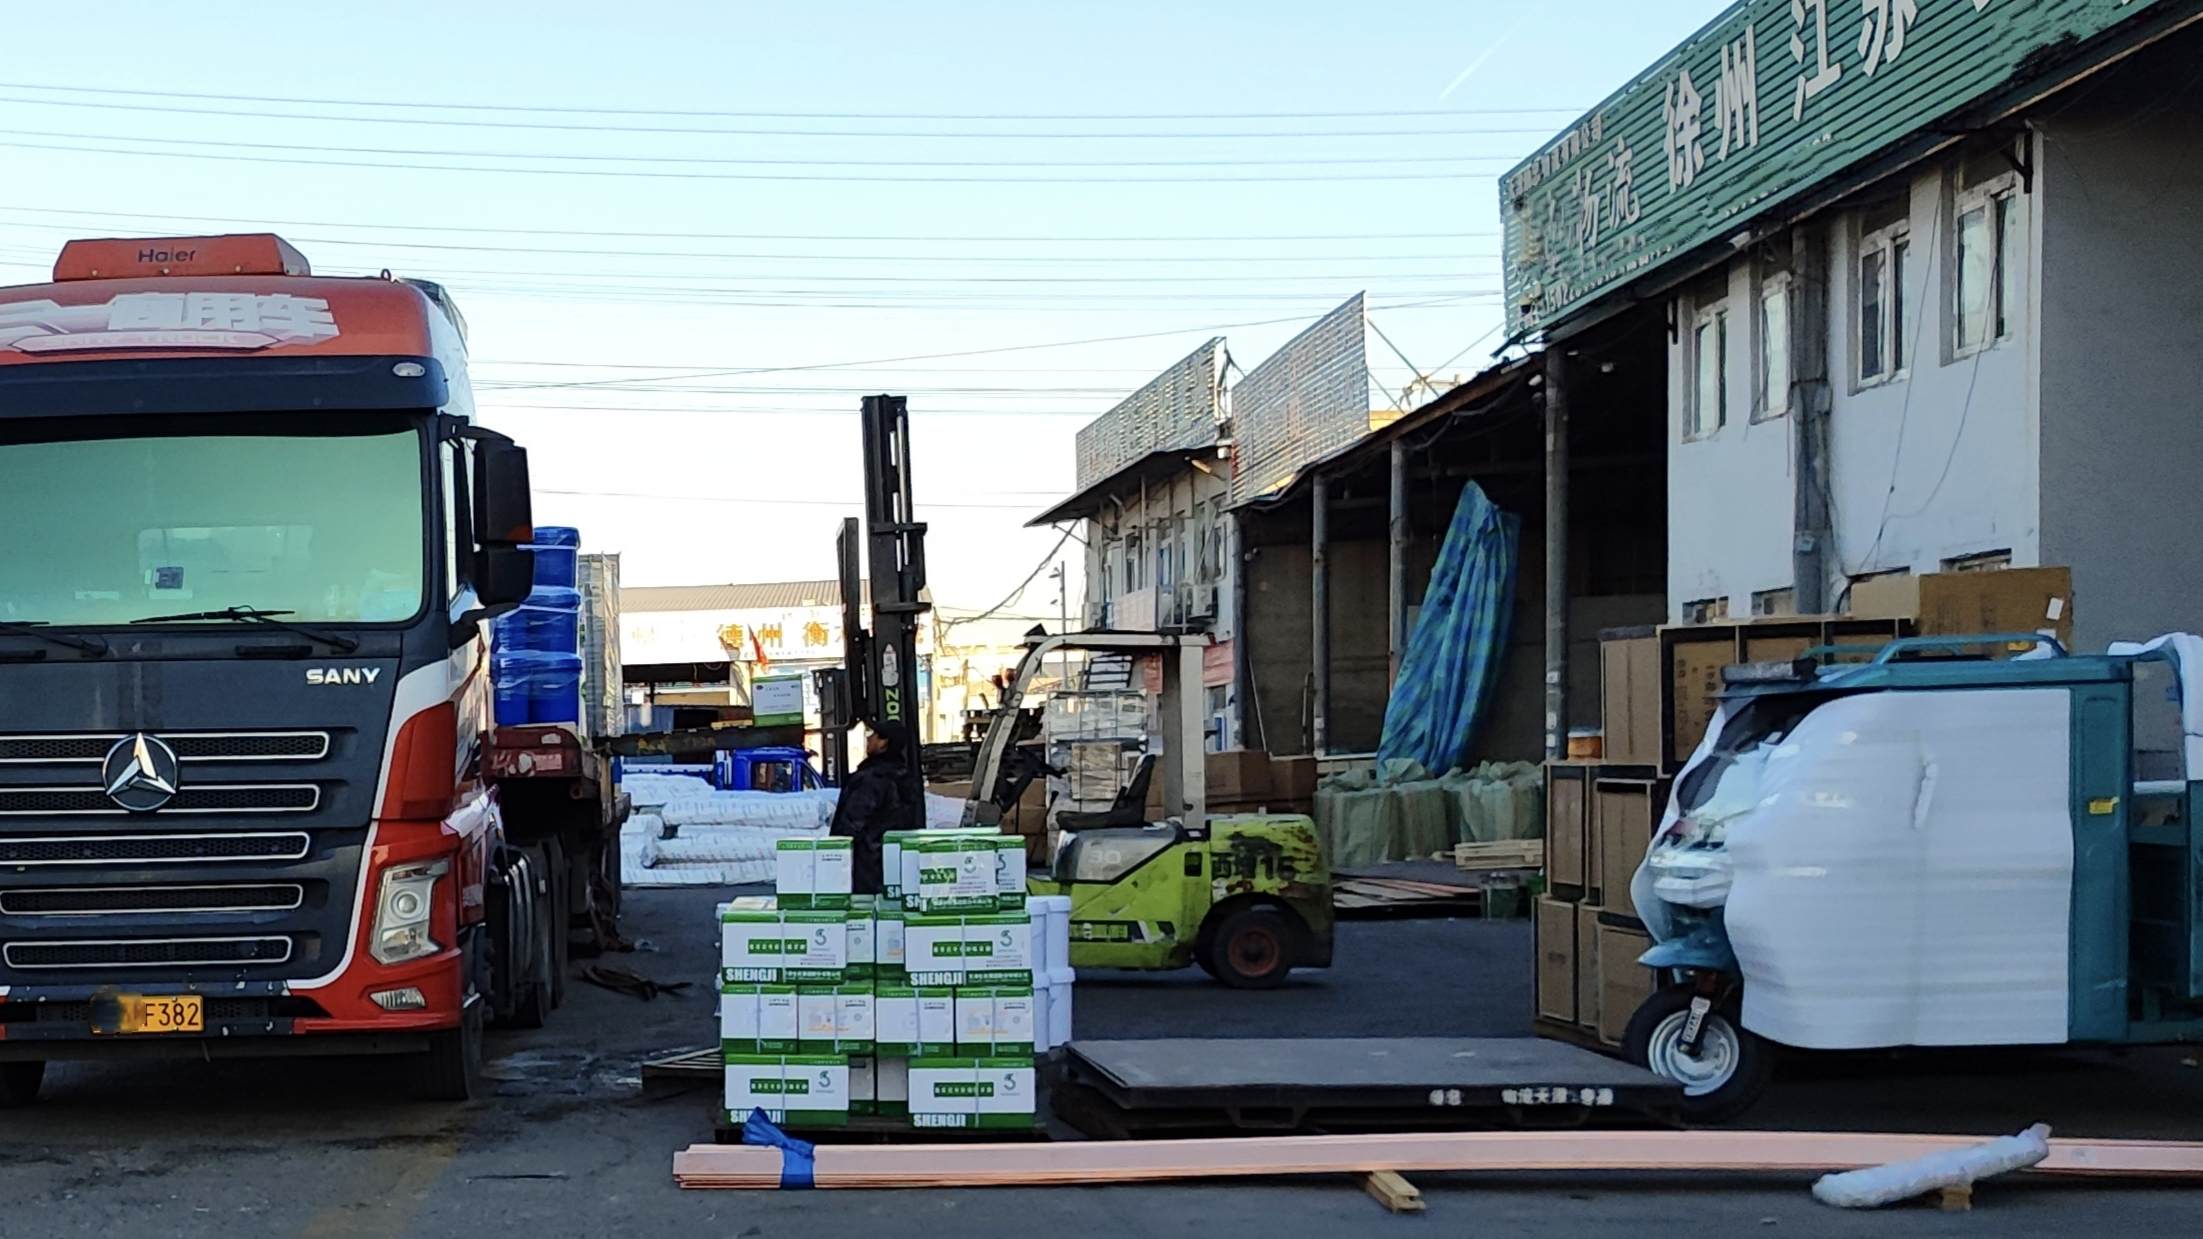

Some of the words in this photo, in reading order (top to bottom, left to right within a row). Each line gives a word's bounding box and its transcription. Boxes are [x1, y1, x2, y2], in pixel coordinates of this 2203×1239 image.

[1662, 24, 1760, 195] 徐州
[138, 248, 197, 263] Haier
[717, 622, 784, 649] 德州
[306, 667, 381, 685] SANY
[726, 967, 777, 982] SHENGJI
[910, 971, 963, 986] SHENGJI
[130, 1002, 199, 1027] F382
[913, 1114, 967, 1128] SHENGJI
